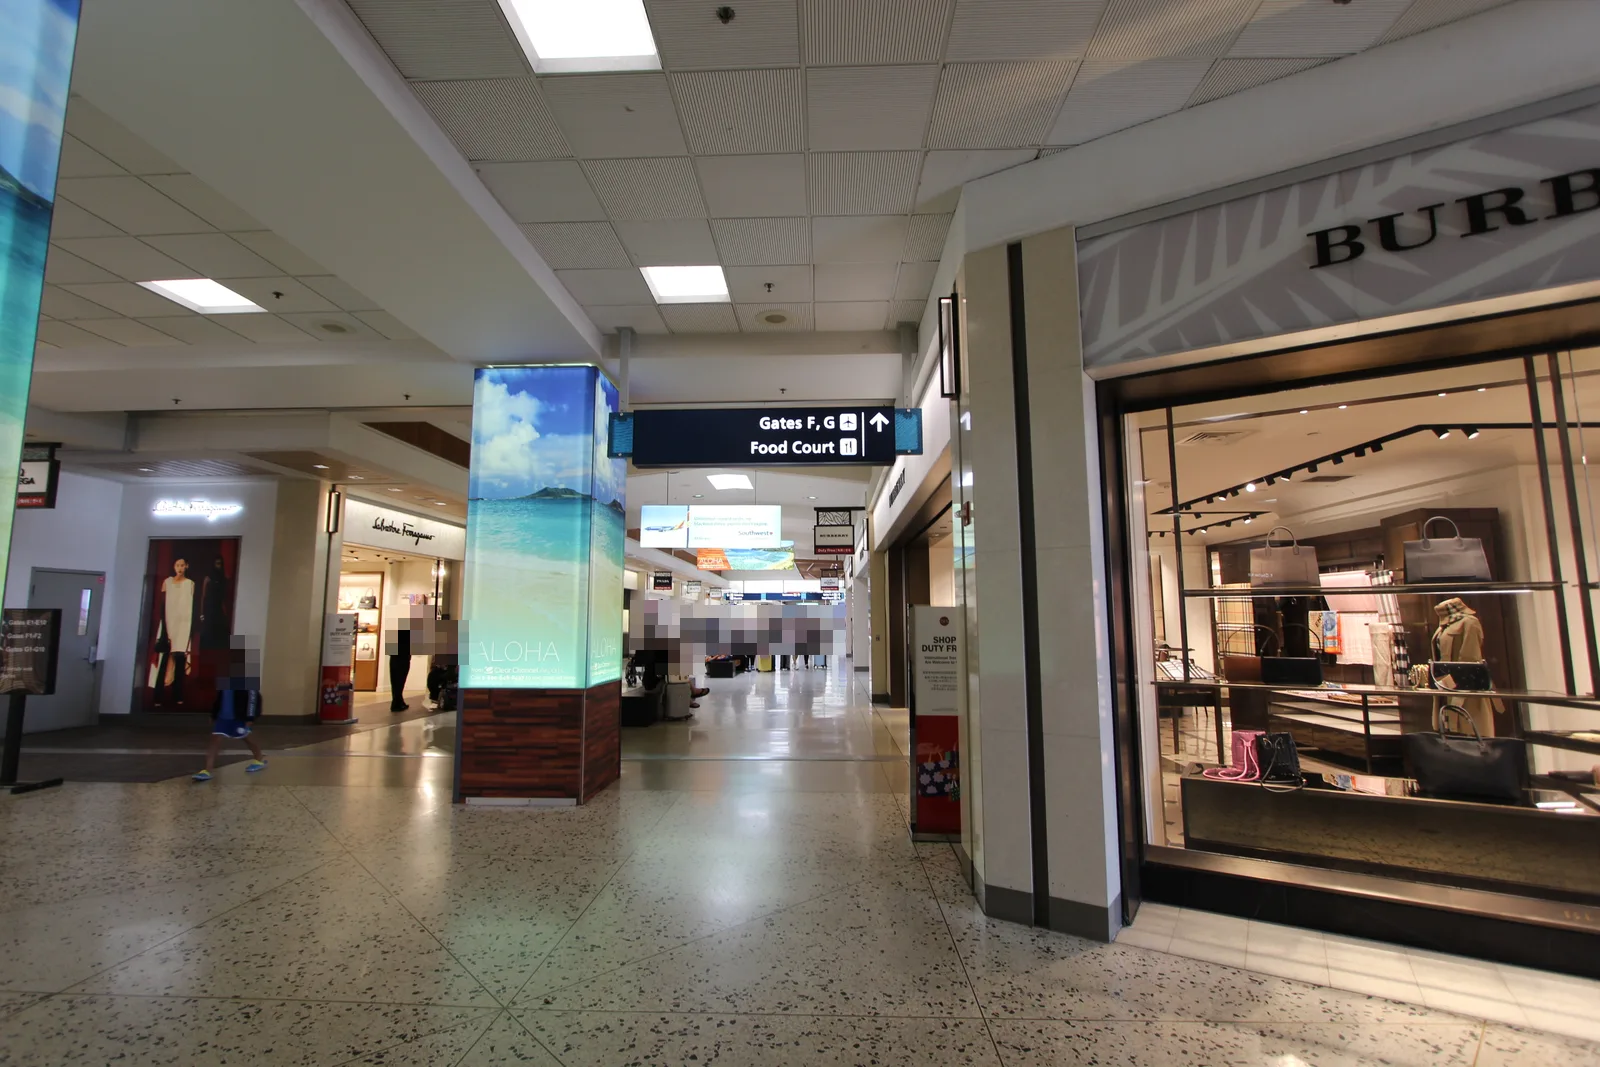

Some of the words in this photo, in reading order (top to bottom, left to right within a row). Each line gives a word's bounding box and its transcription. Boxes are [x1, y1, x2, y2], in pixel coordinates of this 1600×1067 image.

[1306, 167, 1600, 270] BURB
[759, 416, 802, 430] Gates
[807, 416, 821, 431] F,
[823, 416, 835, 429] G
[750, 440, 788, 454] Food
[792, 441, 835, 454] Court
[699, 557, 724, 565] ALOHA
[933, 636, 956, 644] SHOP
[479, 641, 560, 662] ALOHA
[921, 644, 944, 652] DUTY
[946, 644, 957, 652] FR
